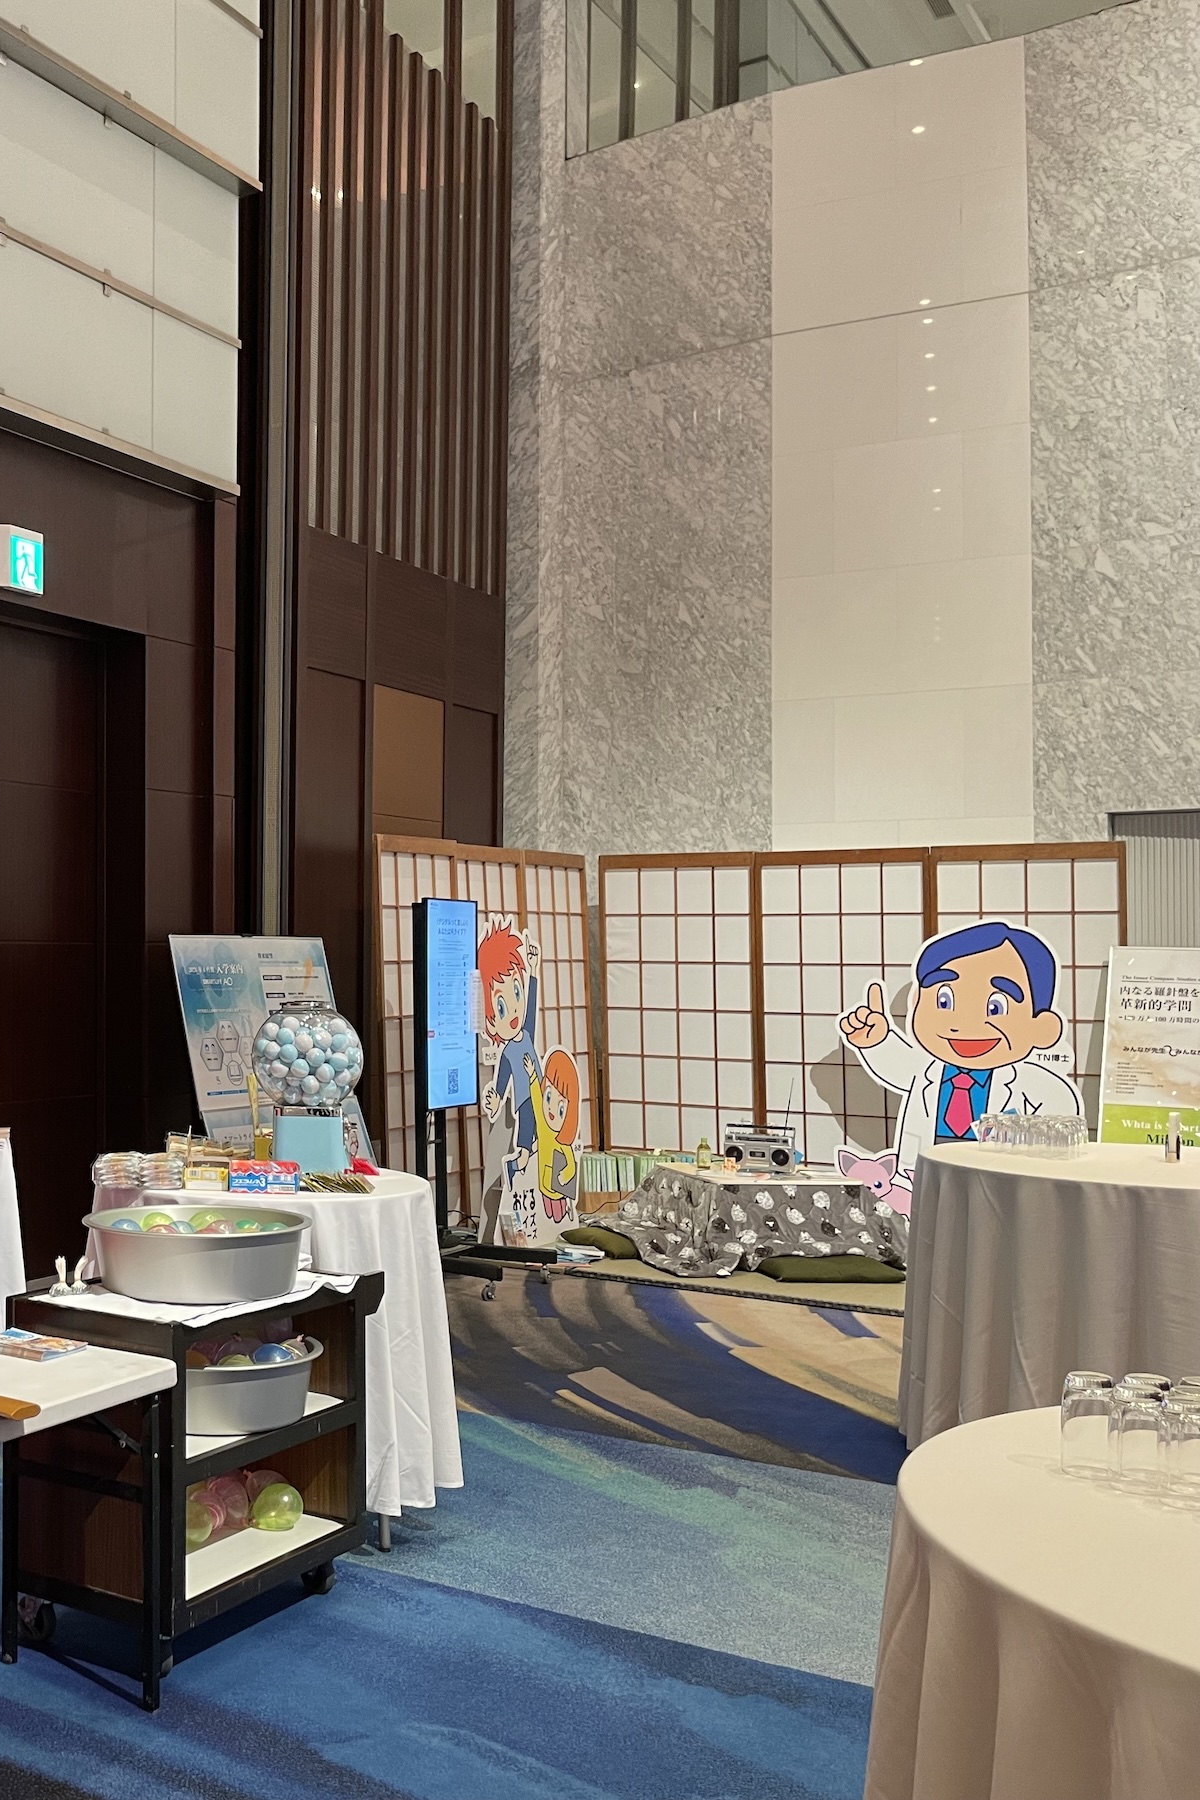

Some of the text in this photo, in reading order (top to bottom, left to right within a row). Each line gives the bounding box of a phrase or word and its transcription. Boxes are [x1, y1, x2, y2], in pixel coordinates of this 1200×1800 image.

[1120, 986, 1200, 998] 内なる羅針盤を
[1120, 998, 1192, 1012] 革新的学問
[1036, 1053, 1070, 1062] TN博士
[1154, 1120, 1162, 1130] is
[1166, 1122, 1199, 1132] Sart
[513, 1189, 536, 1211] おどる
[523, 1212, 536, 1228] イズ
